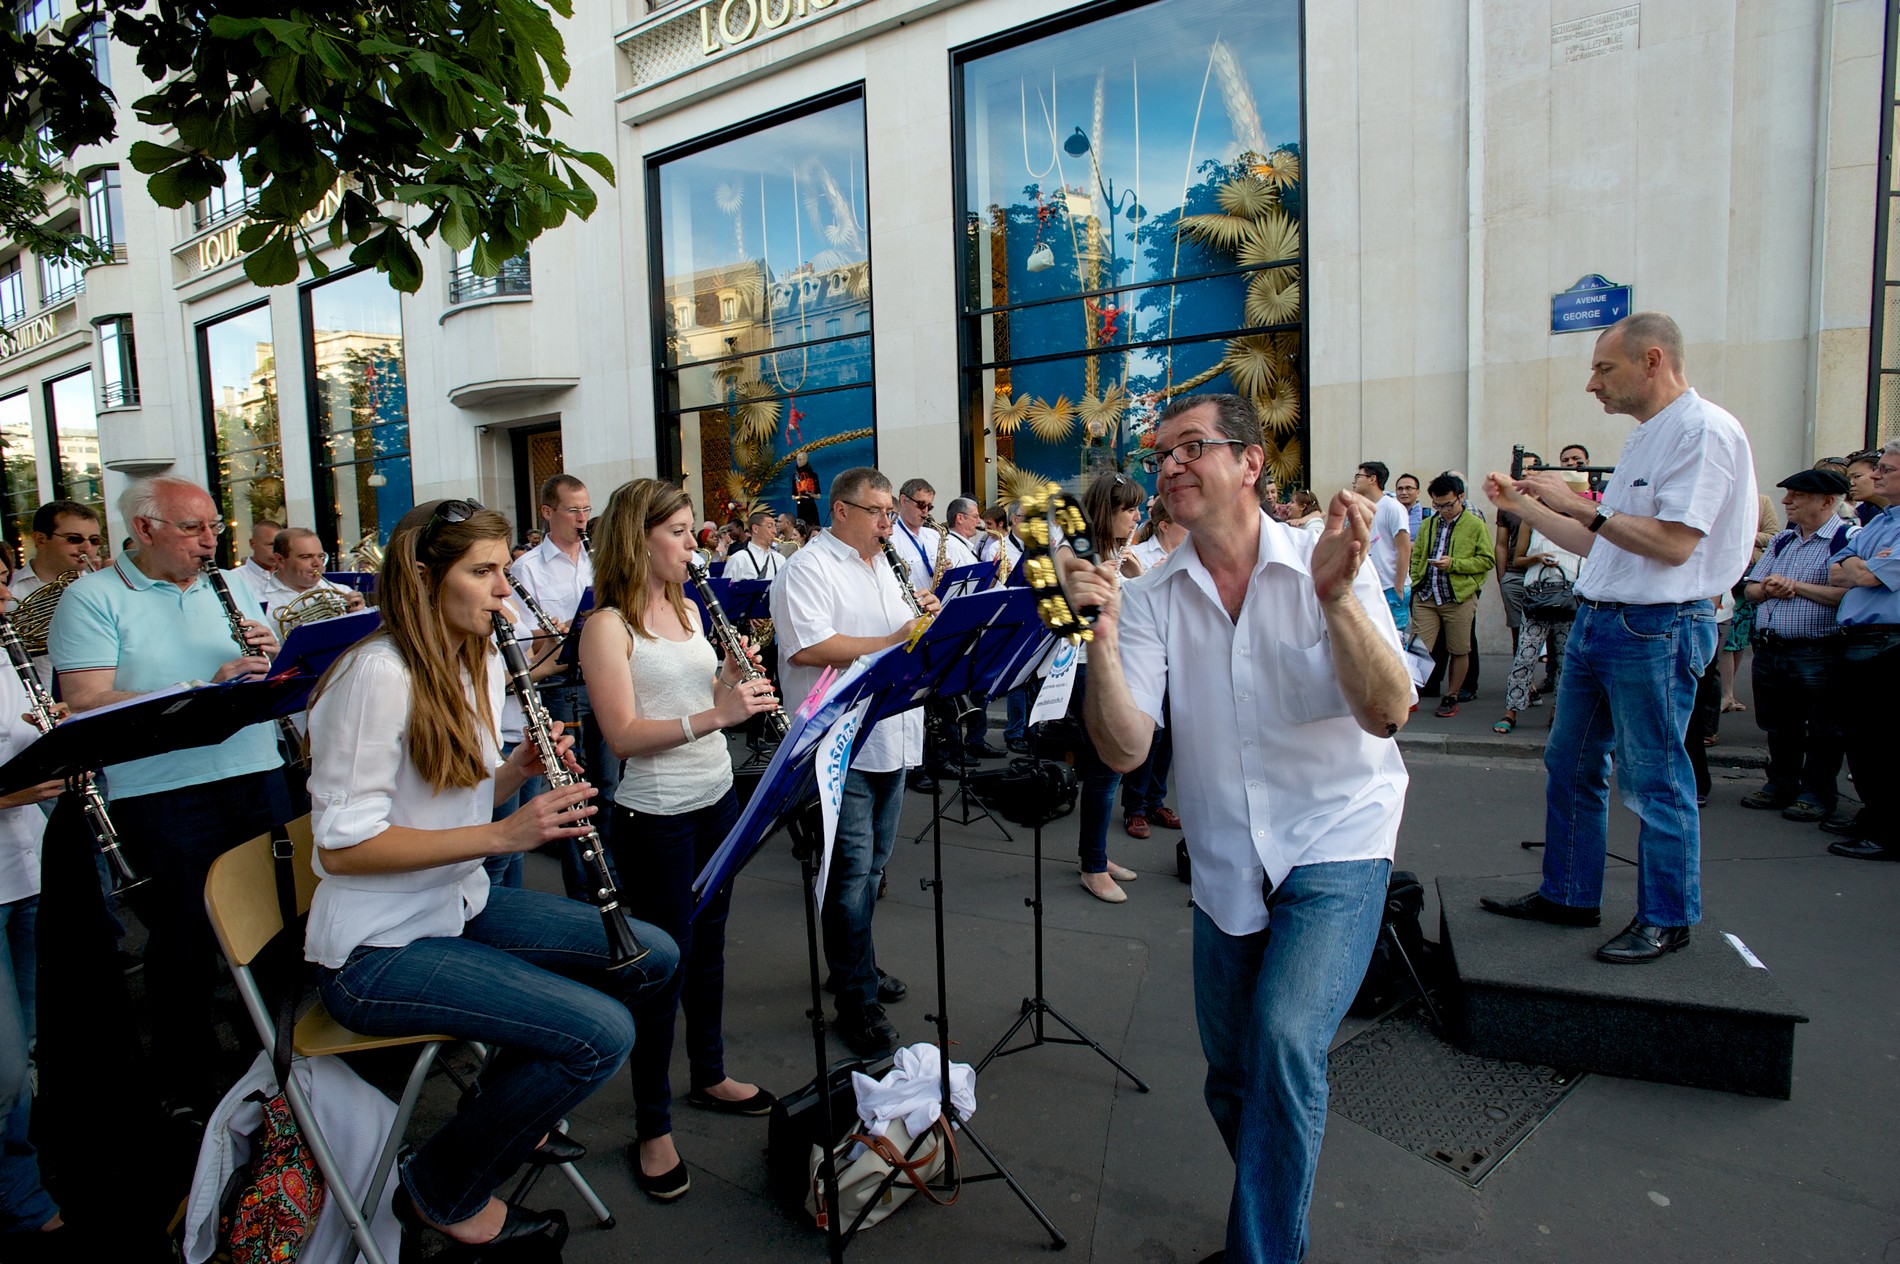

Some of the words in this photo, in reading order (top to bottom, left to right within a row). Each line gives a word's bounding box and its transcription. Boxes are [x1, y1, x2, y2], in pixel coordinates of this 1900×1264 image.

[700, 0, 838, 55] LOU
[1575, 294, 1607, 305] AVENUE
[1563, 309, 1600, 321] GEORGE
[1612, 307, 1620, 316] V
